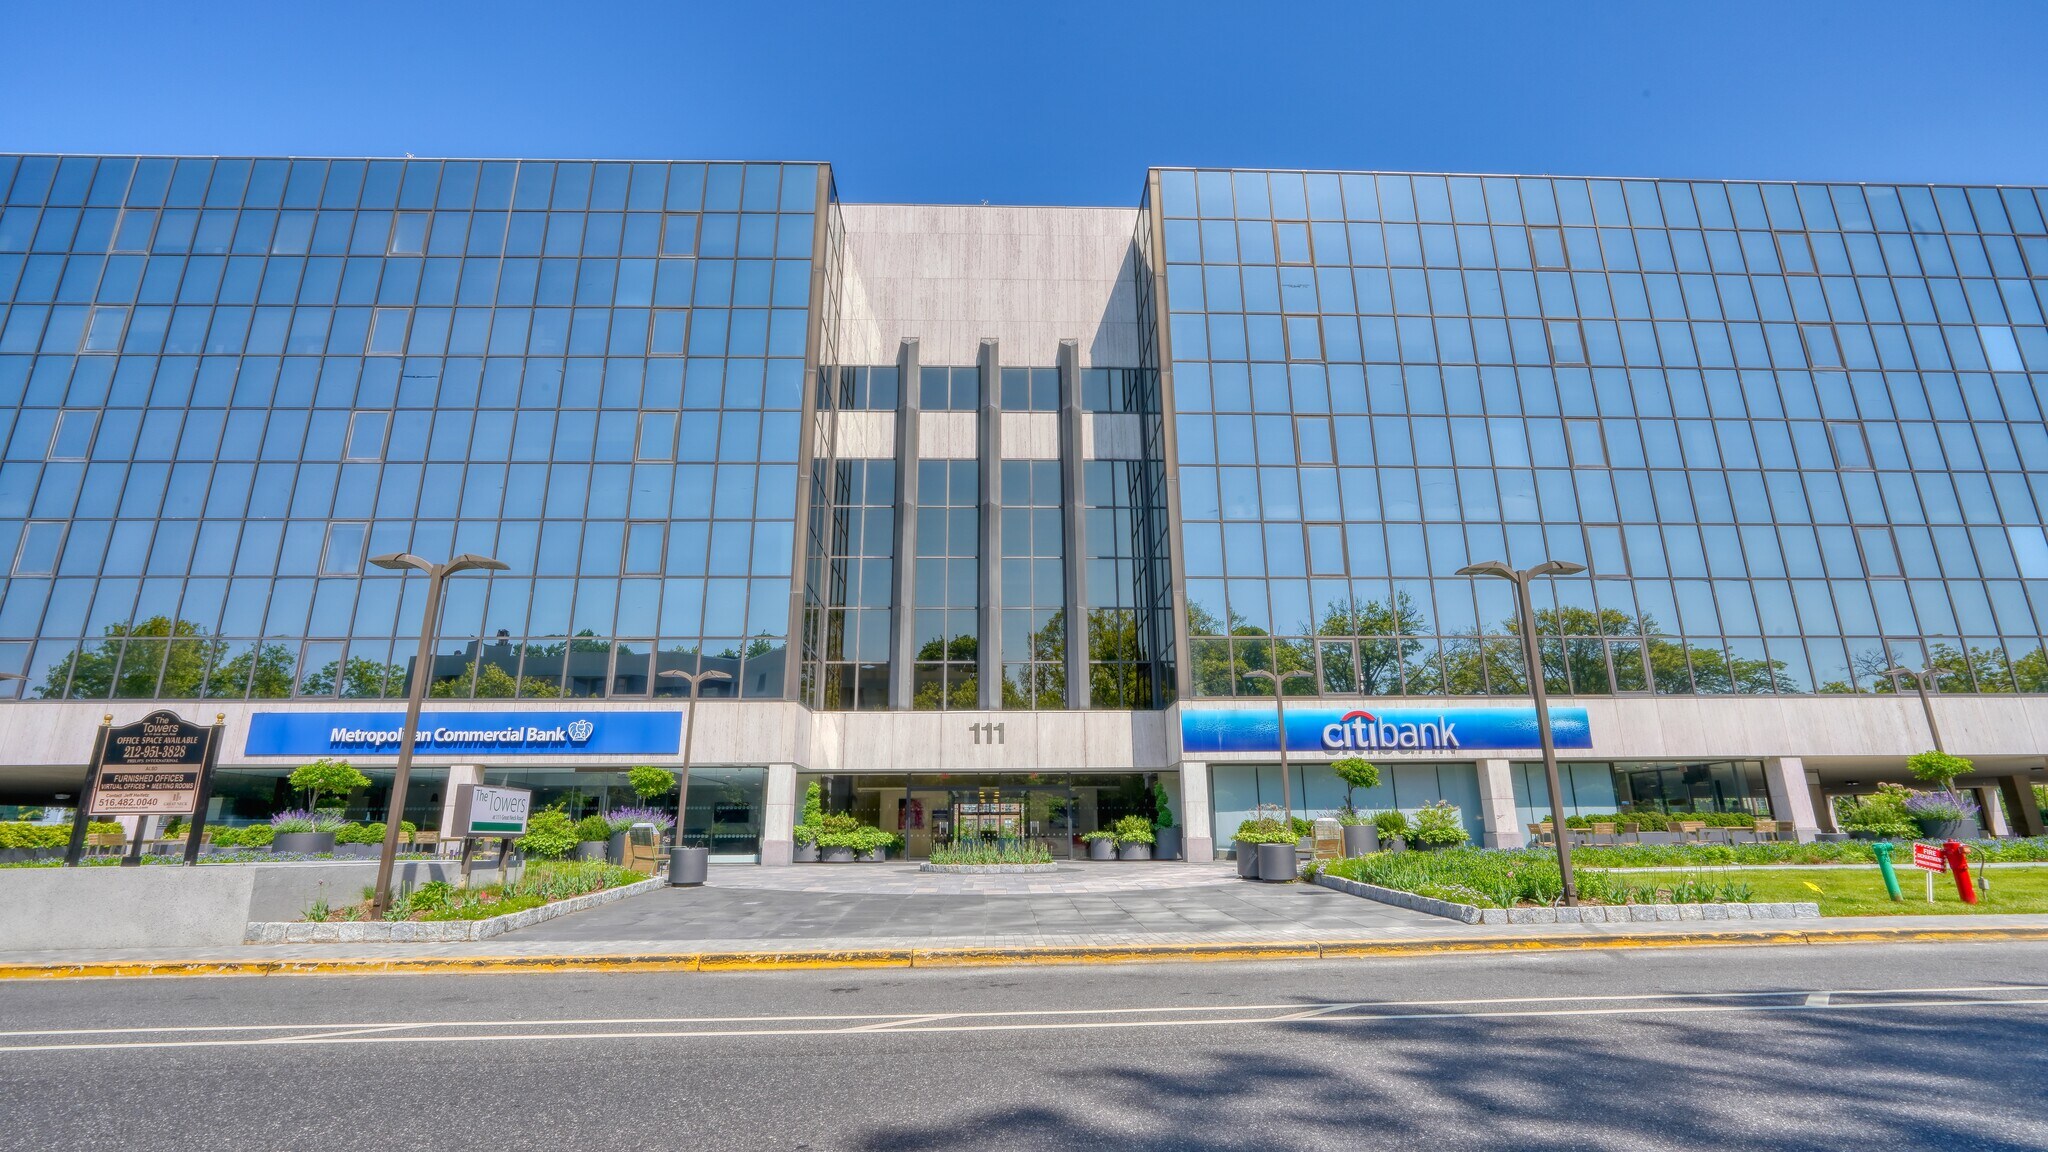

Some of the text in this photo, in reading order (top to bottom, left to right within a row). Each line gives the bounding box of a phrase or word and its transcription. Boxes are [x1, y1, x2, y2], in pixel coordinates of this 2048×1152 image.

[155, 716, 169, 724] The
[142, 722, 179, 733] Towers
[1322, 714, 1460, 748] citibank
[330, 726, 566, 745] Metropolan Commercial Bank
[969, 723, 1004, 744] 111
[141, 736, 163, 744] SPACE
[123, 745, 186, 758] 212-951-3828
[113, 774, 184, 783] FURNISHED OFFICES
[98, 798, 158, 807] 516.482.0040
[476, 789, 526, 813] The Towers
[1923, 849, 1936, 857] FIRE
